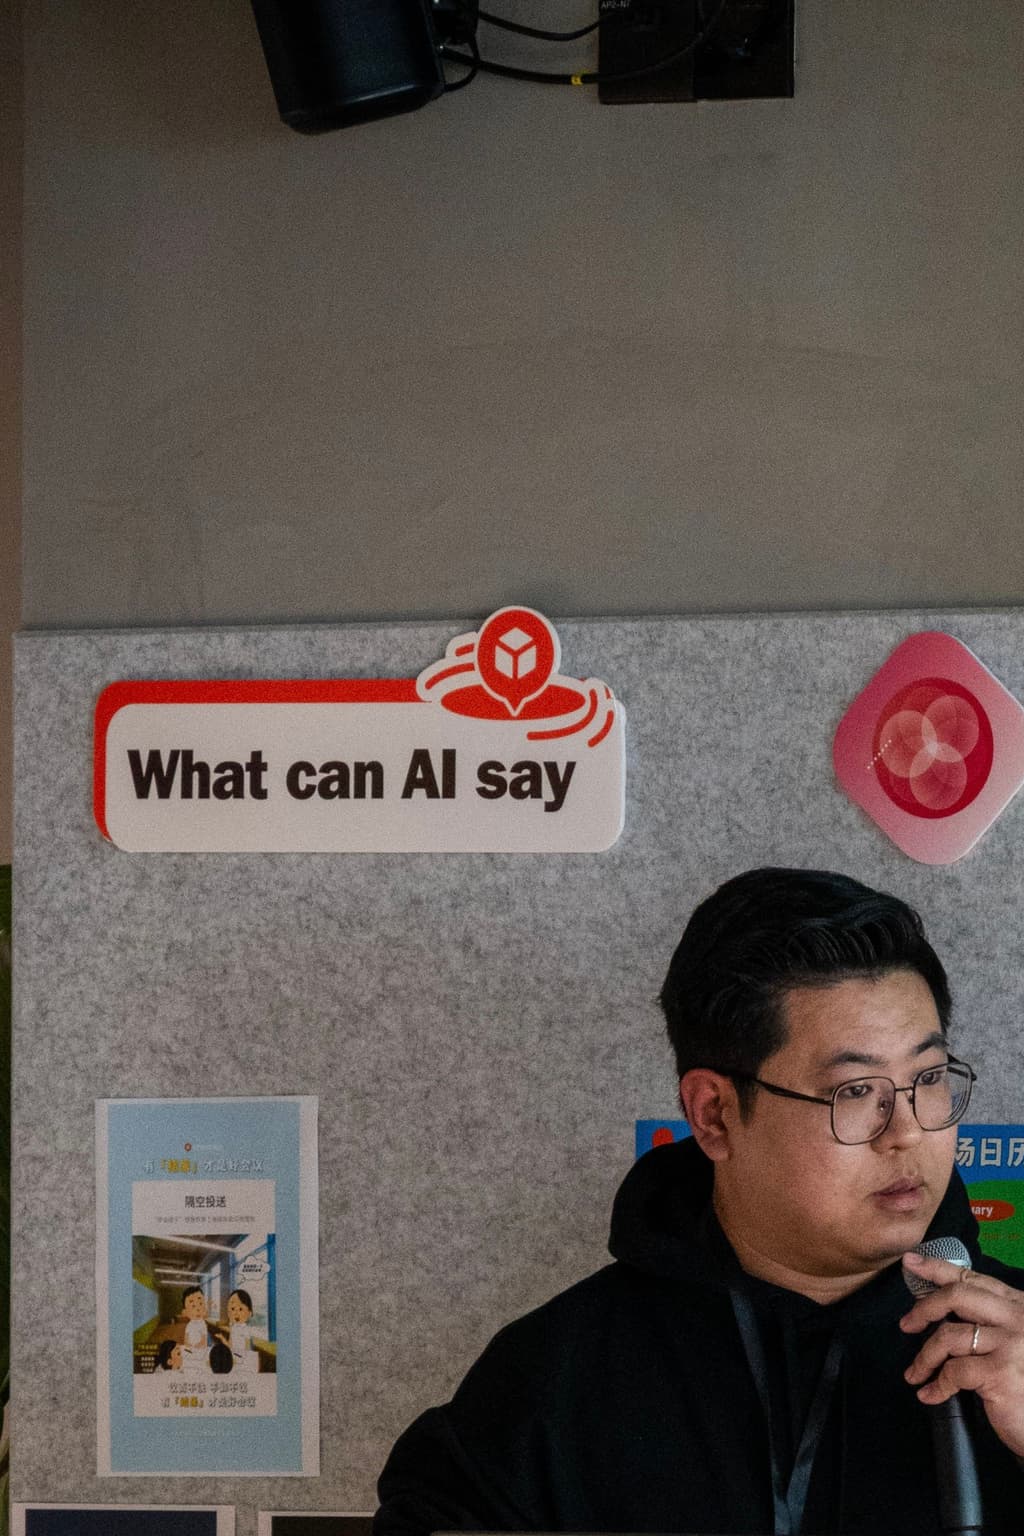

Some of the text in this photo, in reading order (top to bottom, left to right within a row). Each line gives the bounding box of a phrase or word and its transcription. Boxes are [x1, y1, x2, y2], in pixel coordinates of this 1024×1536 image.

[127, 749, 576, 812] What can AI say
[184, 1195, 227, 1209] 隔空投送
